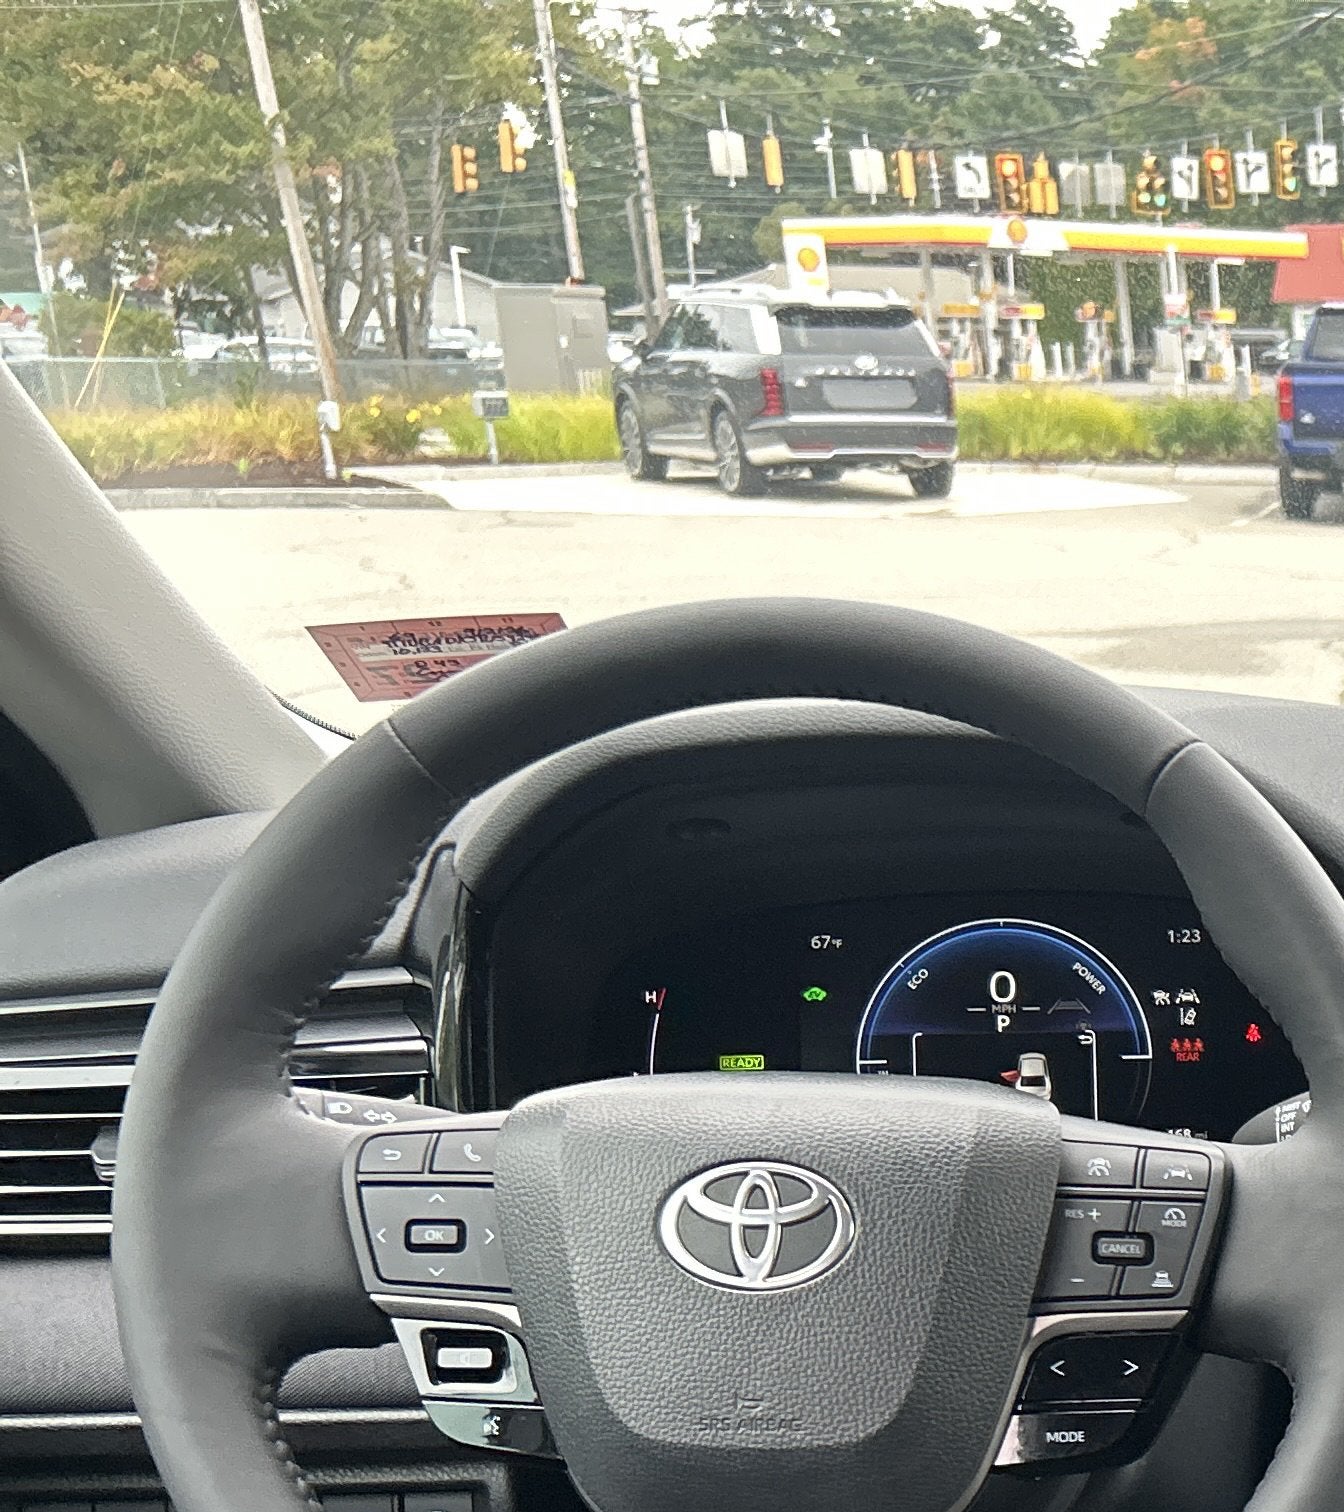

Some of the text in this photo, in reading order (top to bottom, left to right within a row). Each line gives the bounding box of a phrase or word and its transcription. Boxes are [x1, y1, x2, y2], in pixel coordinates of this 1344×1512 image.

[1167, 929, 1202, 944] 1:23
[907, 968, 930, 990] ECO
[1073, 962, 1107, 995] POWER
[989, 970, 1017, 1003] 0
[991, 1003, 1017, 1014] MPH
[997, 1015, 1011, 1032] P
[722, 1056, 762, 1069] READY
[1176, 1052, 1201, 1063] REAR
[1281, 1112, 1297, 1122] OFF
[1064, 1209, 1085, 1219] RES
[424, 1229, 445, 1242] OK
[1100, 1243, 1141, 1254] CANCEL
[1046, 1429, 1086, 1444] MODE
